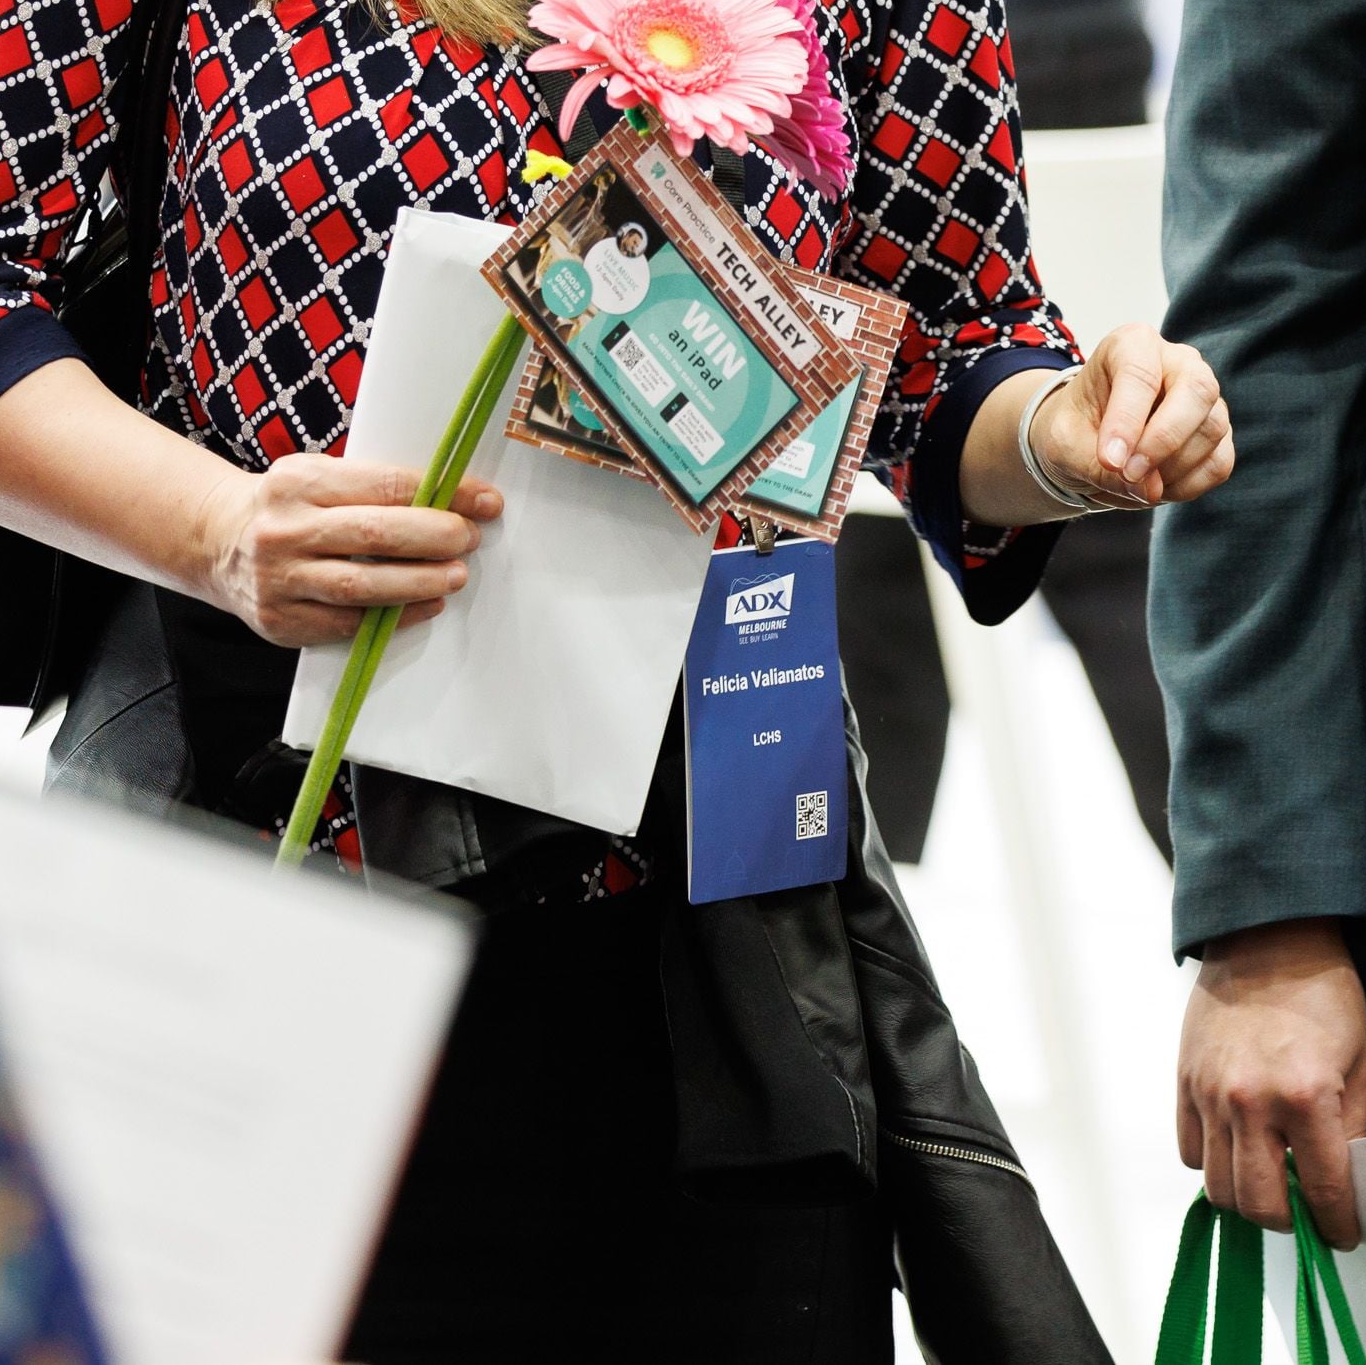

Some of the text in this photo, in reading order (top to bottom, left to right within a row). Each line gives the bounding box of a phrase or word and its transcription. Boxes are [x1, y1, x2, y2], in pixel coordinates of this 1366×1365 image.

[664, 179, 807, 350] Core Practice TECH ALLEY
[554, 274, 580, 304] DRINKS
[561, 267, 580, 289] FOOD
[810, 300, 845, 326] EY
[681, 300, 747, 380] WIN
[668, 330, 723, 391] an iPad
[734, 590, 790, 615] ADX
[739, 619, 788, 635] MELBOURNE
[739, 633, 779, 645] SEE BUY LEARN
[702, 663, 825, 696] Felicia Valianatos
[753, 730, 782, 746] LCHS
